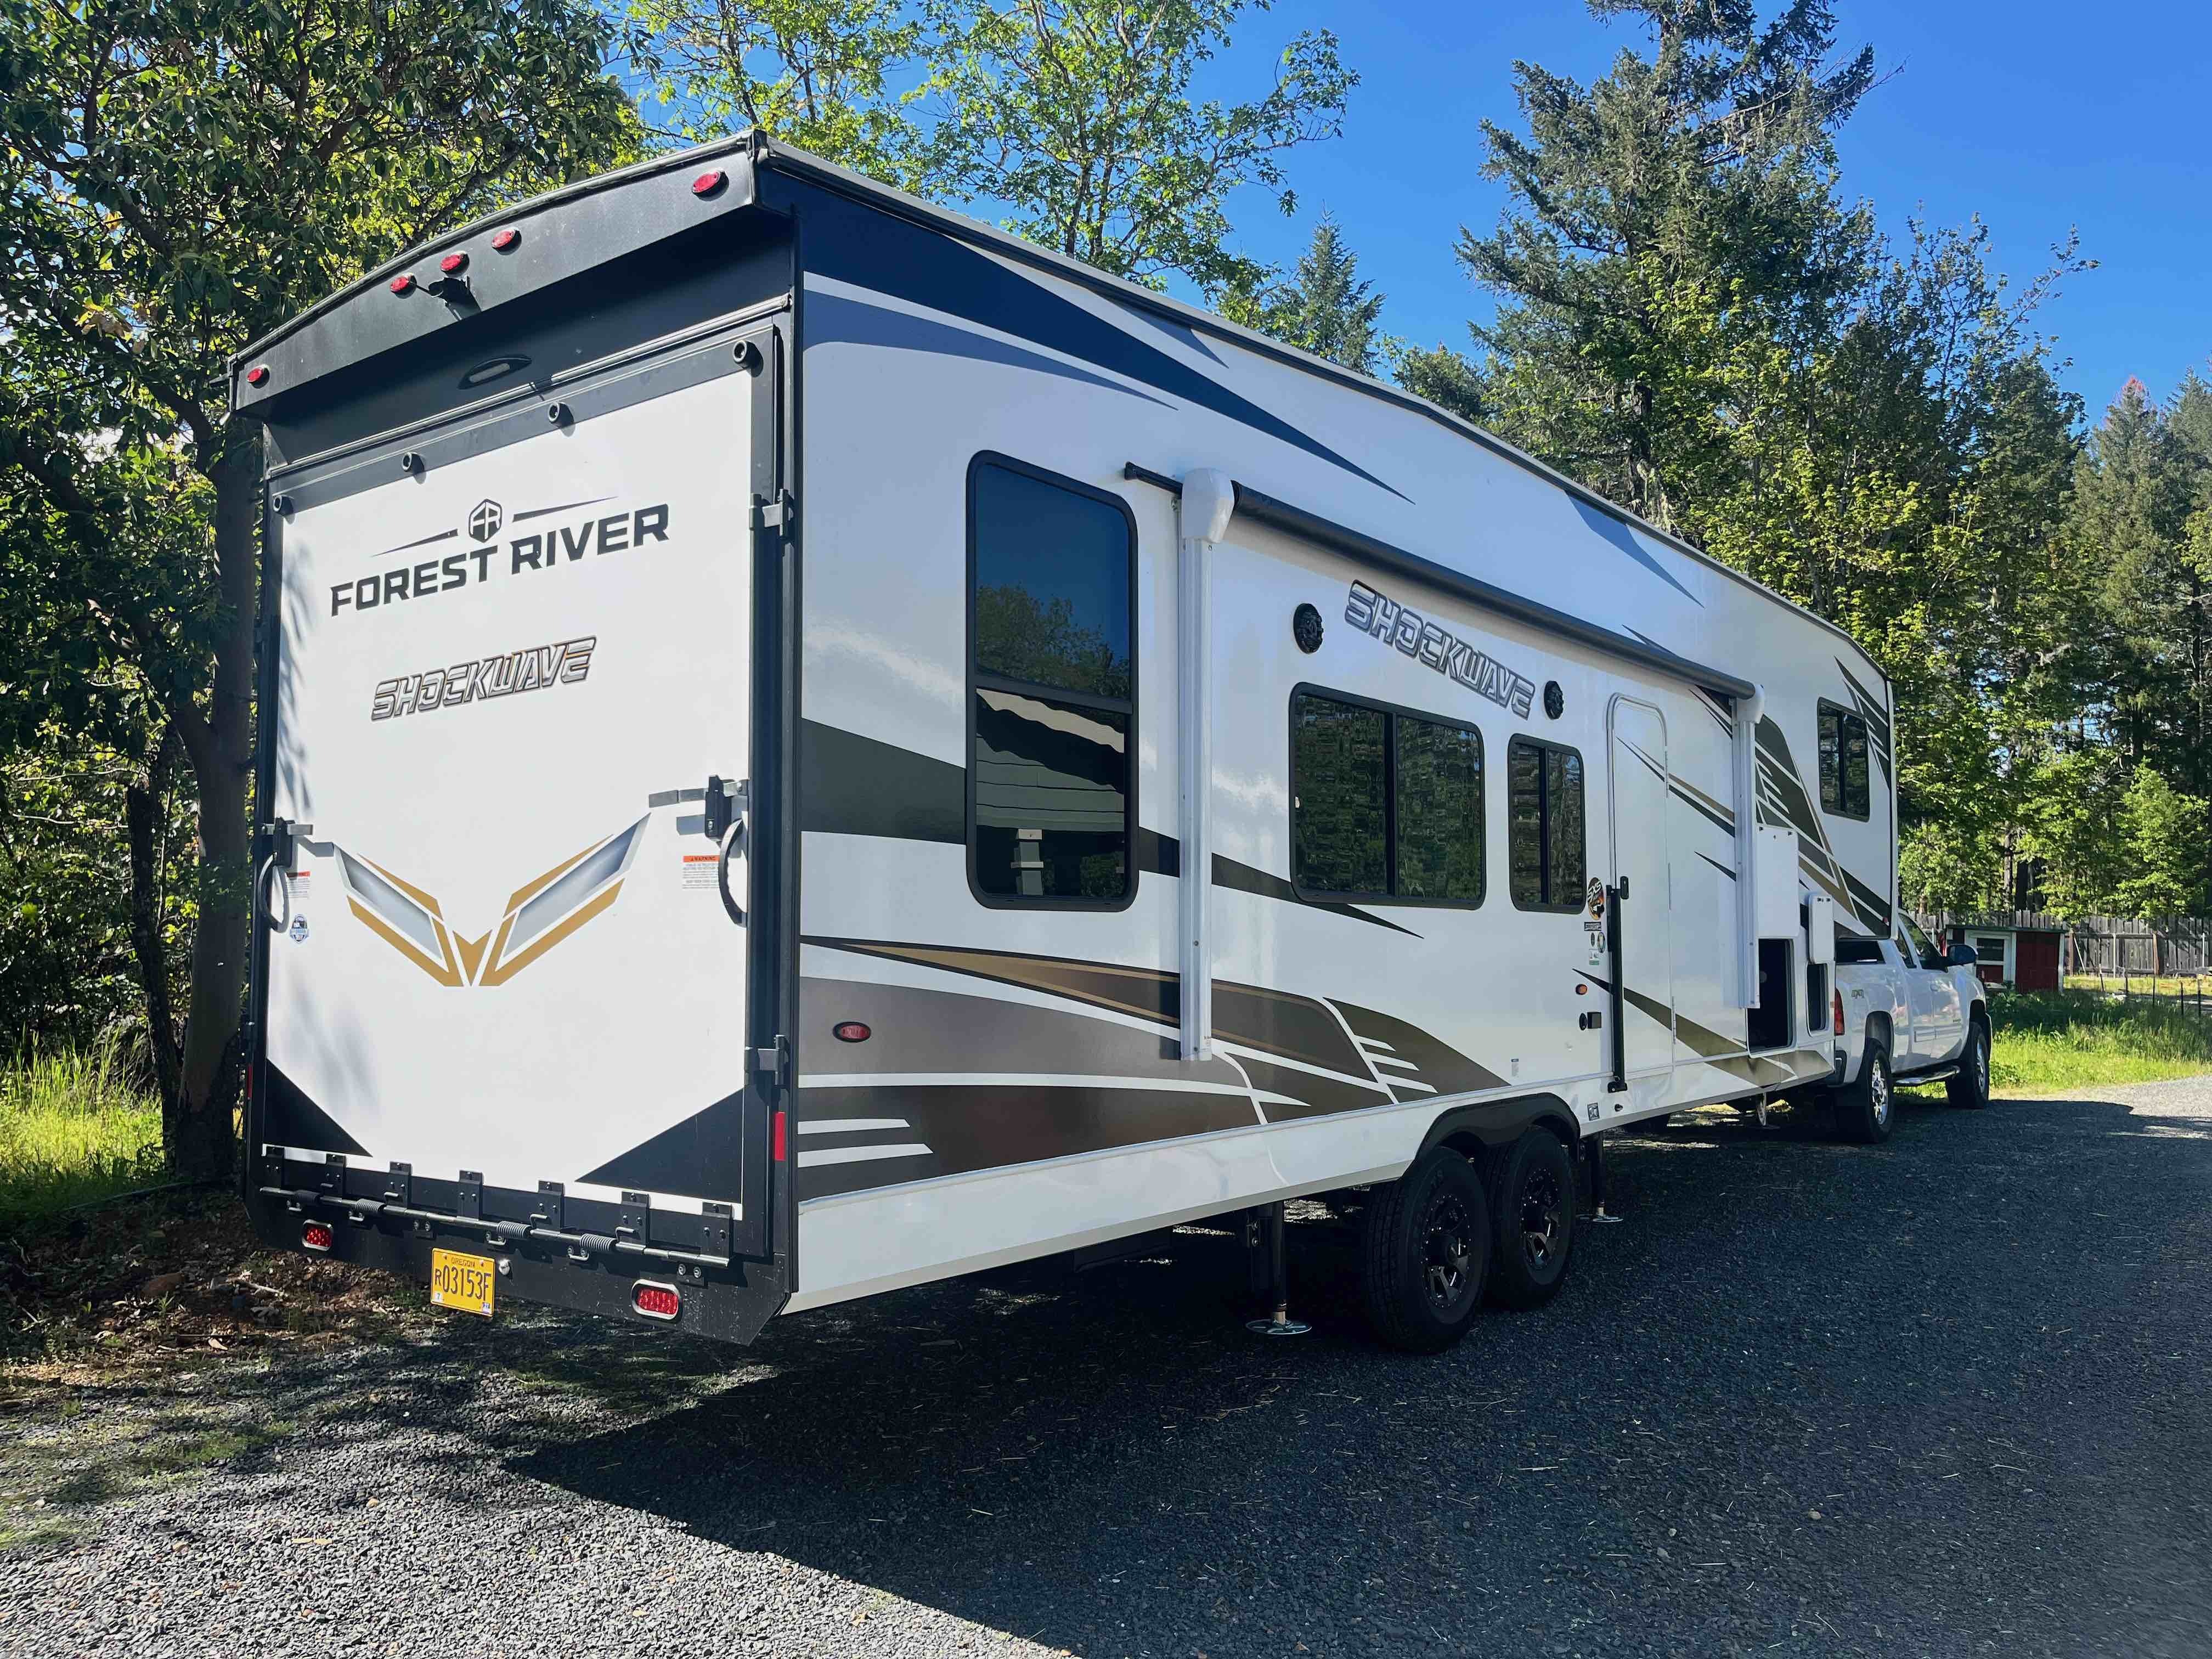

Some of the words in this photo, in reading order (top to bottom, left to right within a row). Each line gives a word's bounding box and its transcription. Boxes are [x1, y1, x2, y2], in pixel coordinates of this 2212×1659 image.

[330, 545, 498, 617] FOREST
[510, 503, 670, 575] RIVER
[371, 635, 597, 722] SHOCKWAVE
[1344, 579, 1536, 720] SHOCKWAVE
[435, 1264, 492, 1301] R03153F
[452, 1257, 475, 1267] OREGON
